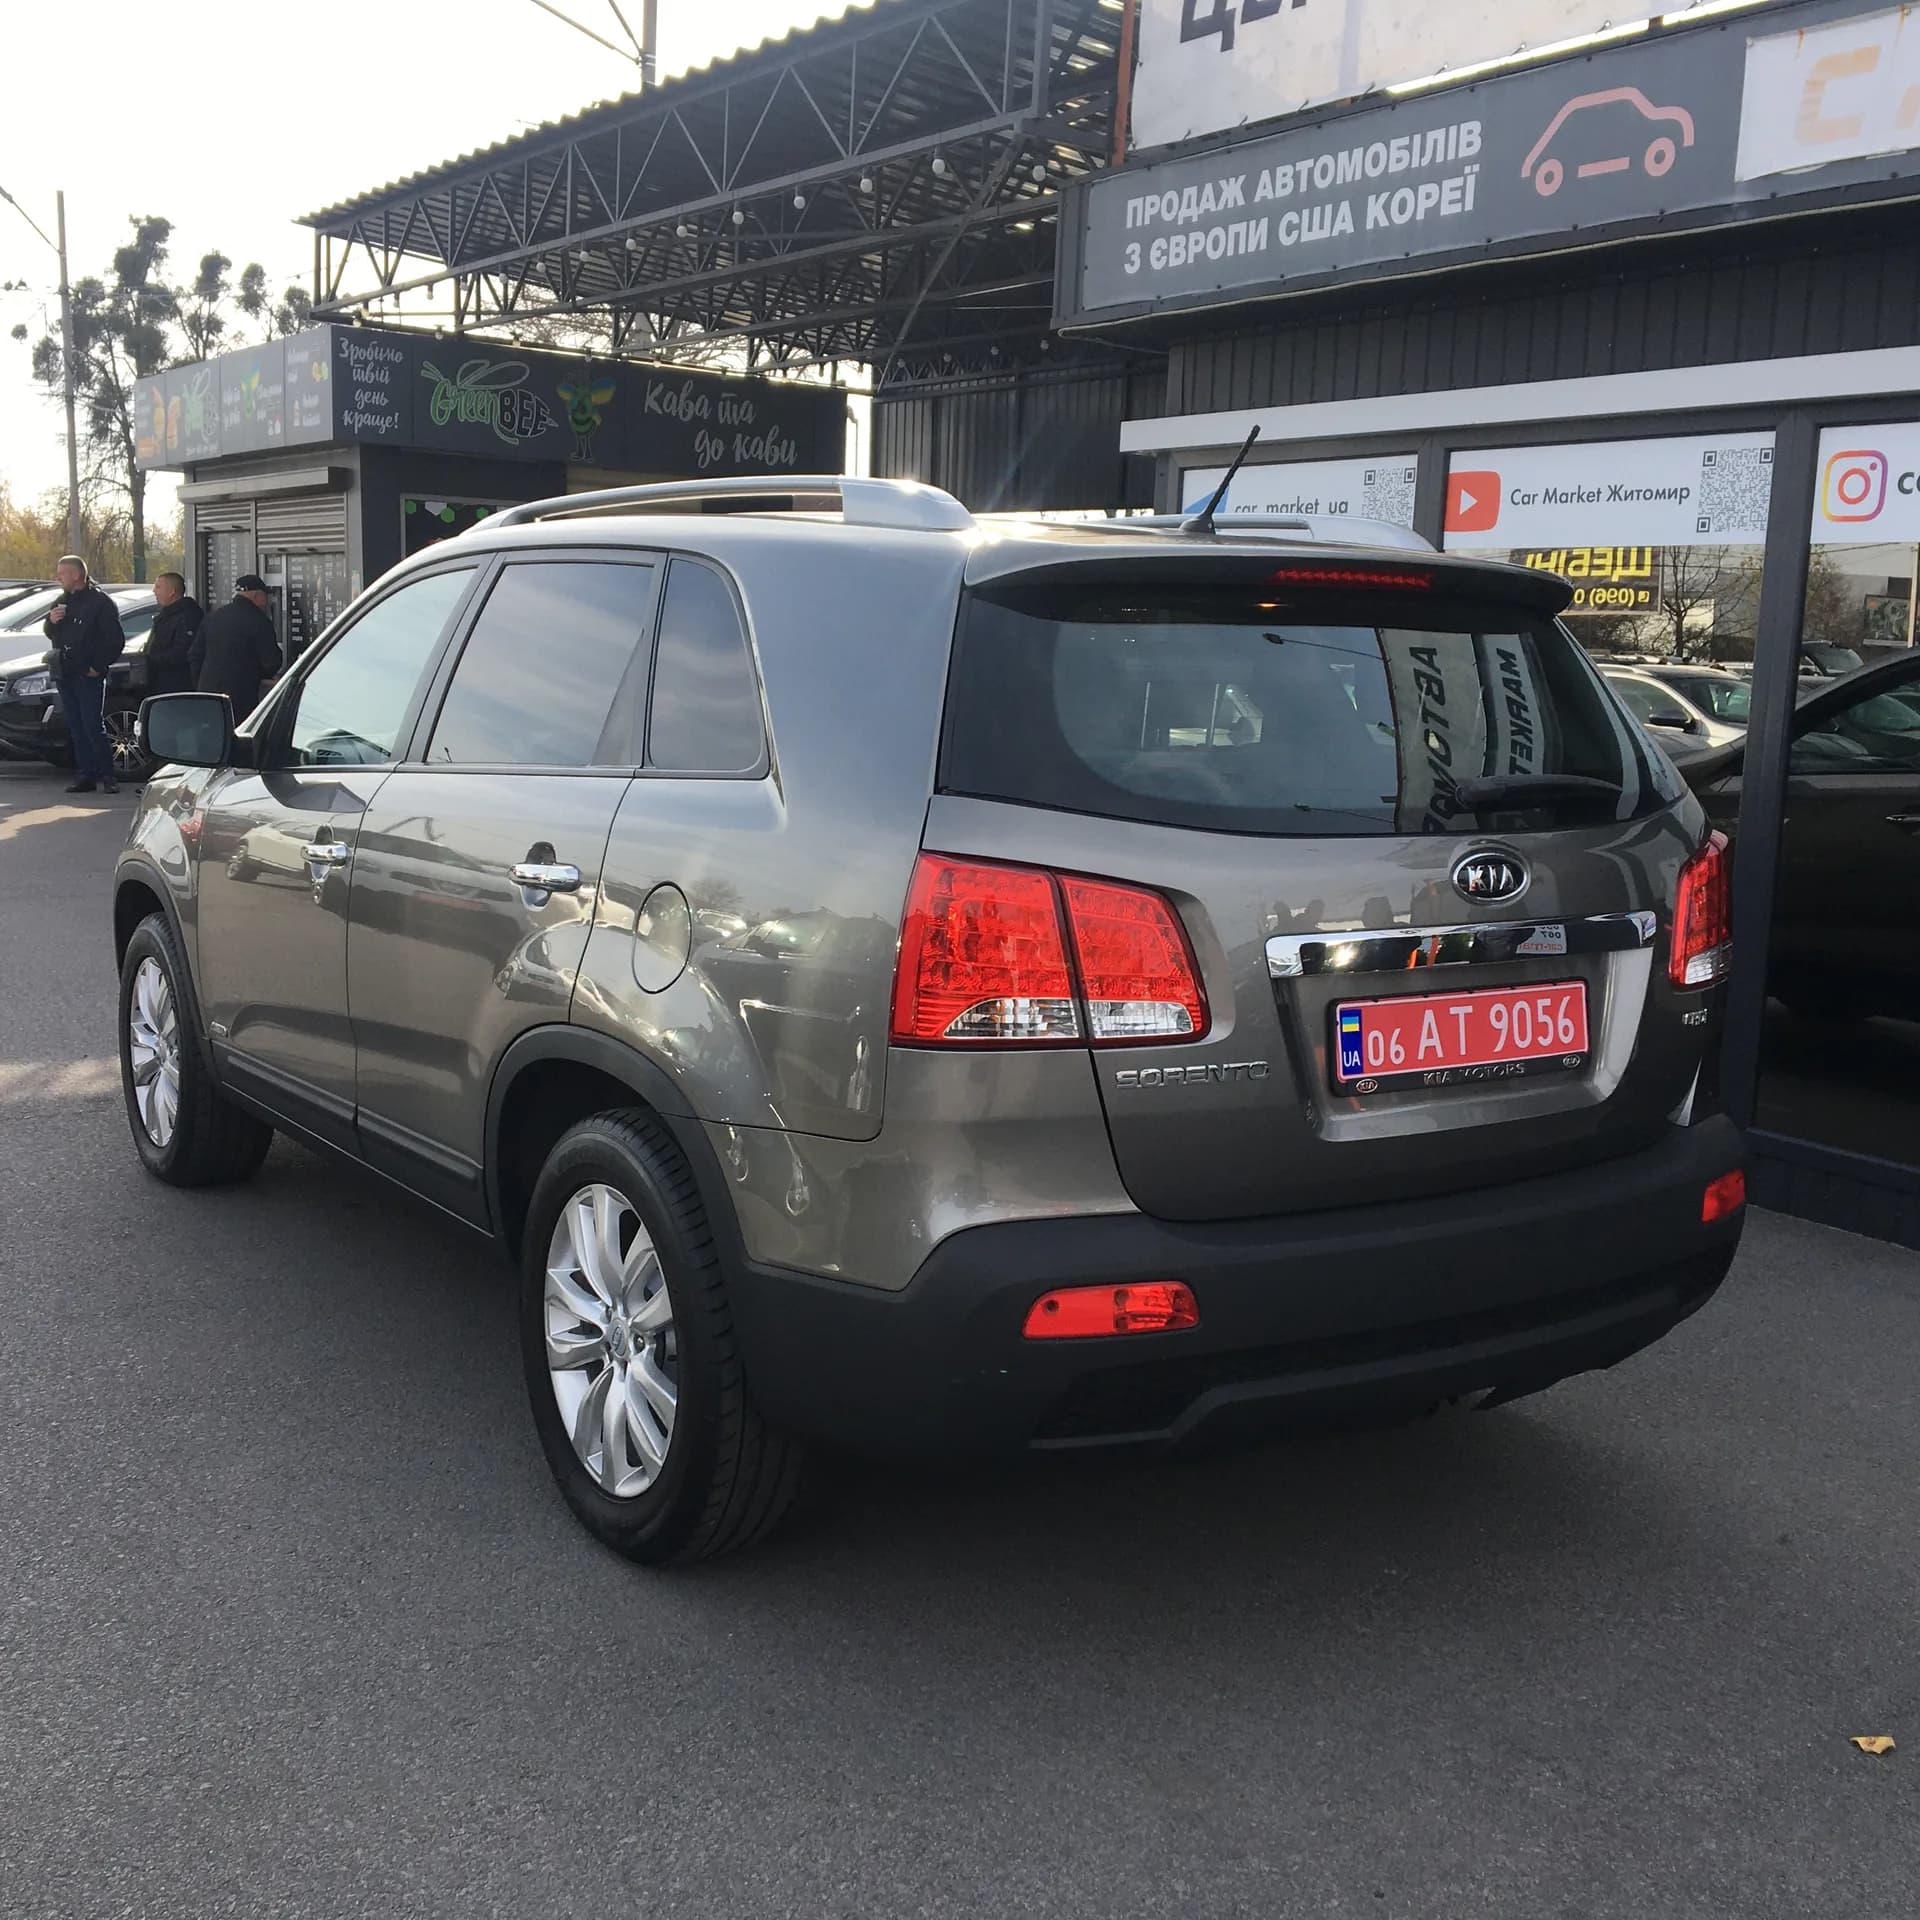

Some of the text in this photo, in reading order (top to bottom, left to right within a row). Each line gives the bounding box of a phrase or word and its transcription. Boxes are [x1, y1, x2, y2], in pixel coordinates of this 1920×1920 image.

[1126, 120, 1482, 229] ПРОДАЖ АВТОМОБІЛІВ
[1124, 163, 1480, 274] З ЄВРОПИ США КОРЕЇ
[352, 362, 391, 385] твій
[354, 388, 389, 409] день
[644, 379, 757, 426] Кава та
[343, 409, 399, 434] краще!
[694, 424, 798, 469] до кави
[1510, 484, 1690, 506] Car Market Житомир
[1466, 864, 1516, 893] KIA
[1367, 996, 1575, 1067] 06 AT 9056
[1343, 1051, 1361, 1067] UA
[1116, 1060, 1269, 1088] SORENTO
